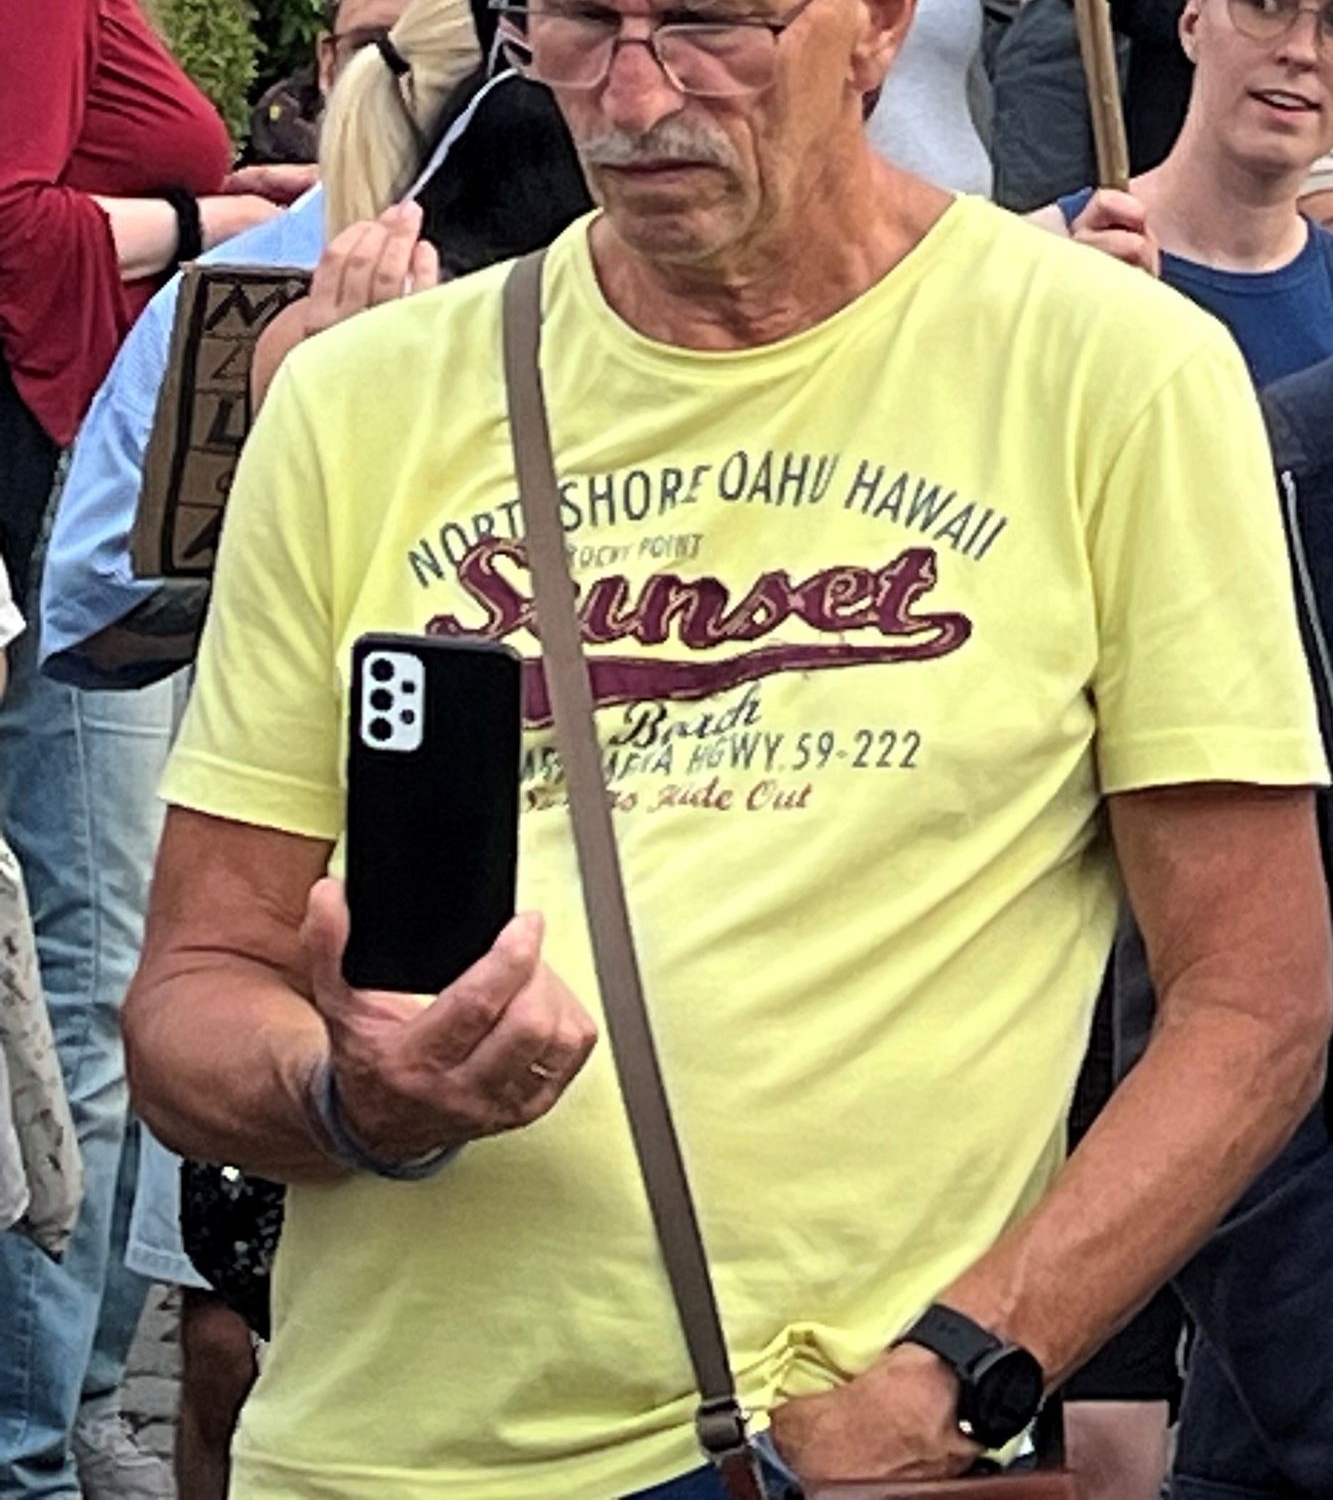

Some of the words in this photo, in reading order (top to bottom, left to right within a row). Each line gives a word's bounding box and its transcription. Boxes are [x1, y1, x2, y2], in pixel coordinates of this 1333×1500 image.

[406, 498, 524, 589] NORT
[560, 463, 712, 533] SHORE
[716, 449, 839, 507] OAHU
[844, 458, 1009, 563] HAWAII
[638, 531, 705, 562] POINT
[425, 535, 972, 650] Sunset
[745, 781, 813, 811] Out
